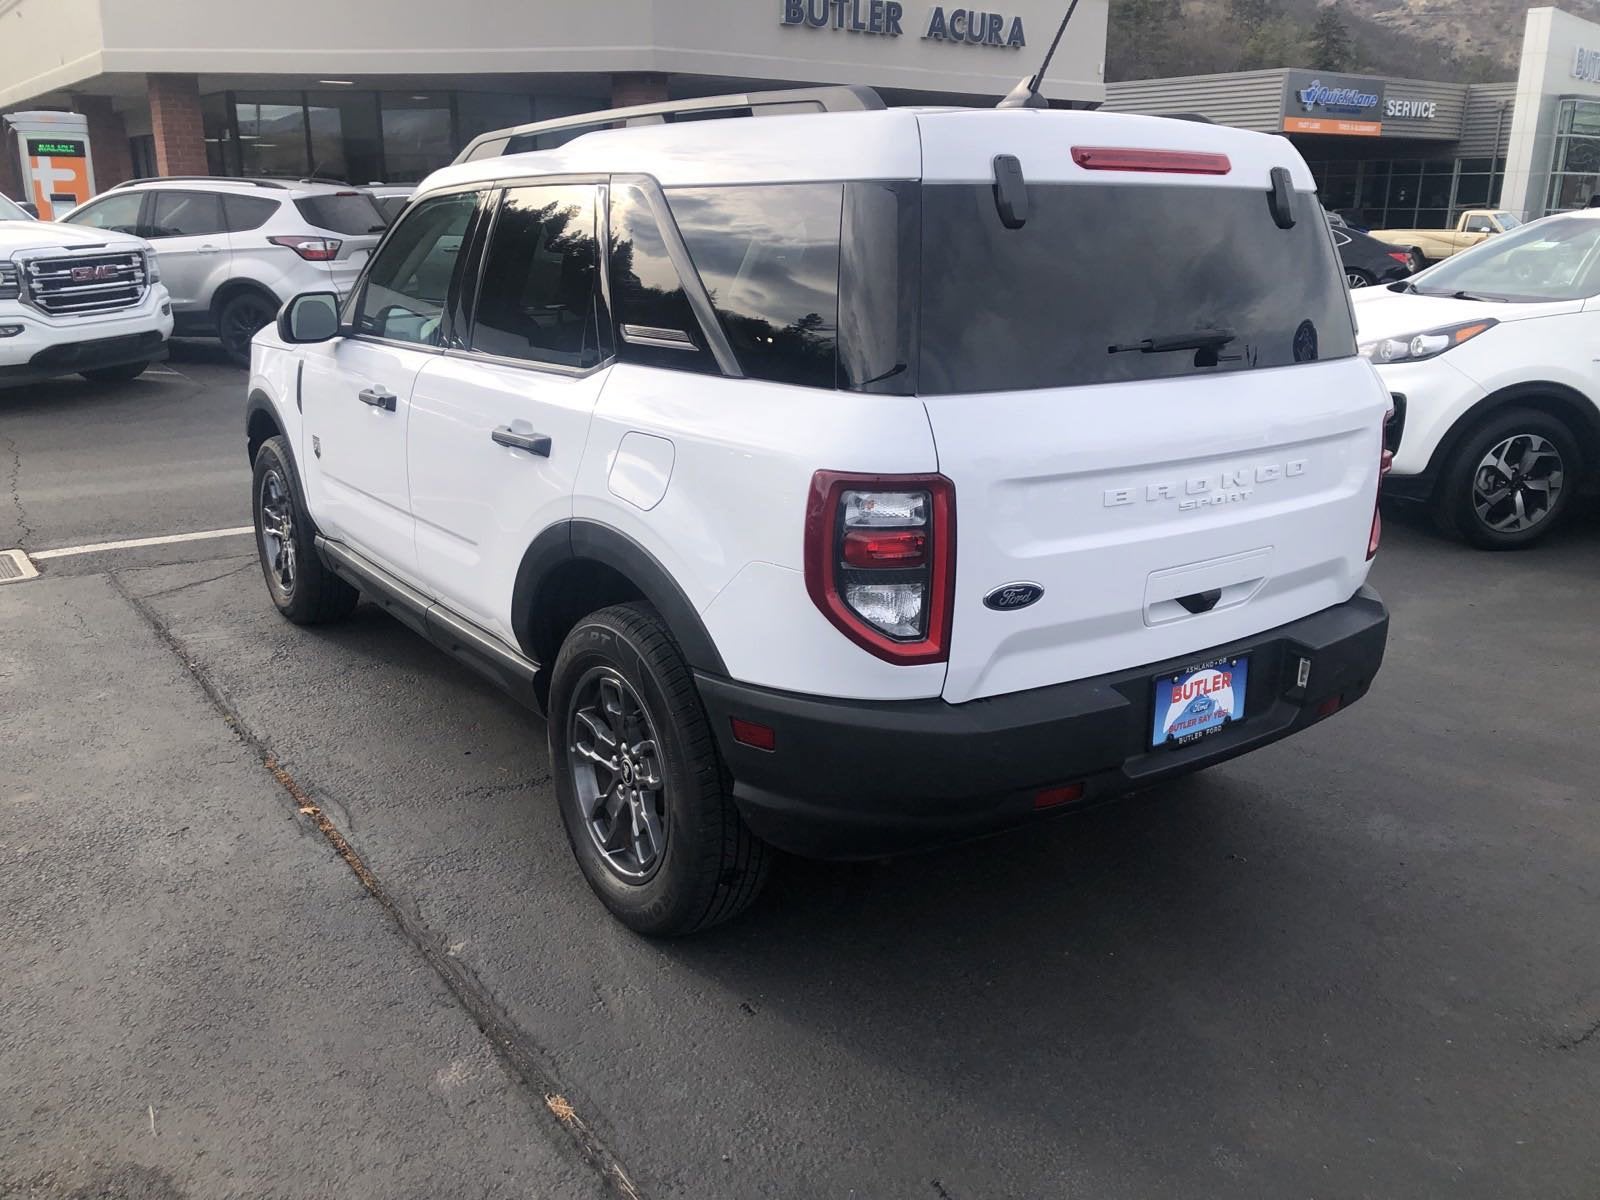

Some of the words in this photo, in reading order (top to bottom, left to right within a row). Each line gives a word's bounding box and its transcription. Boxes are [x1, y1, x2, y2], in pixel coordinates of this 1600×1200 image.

[783, 0, 904, 36] BUTLER
[924, 6, 1027, 47] ACURA
[1387, 99, 1437, 118] SERVICE
[71, 264, 119, 282] GMC
[1103, 459, 1308, 507] BRONCO
[1178, 489, 1253, 511] SPORT
[1171, 671, 1232, 704] BUTLER
[1178, 731, 1203, 745] BUTLER
